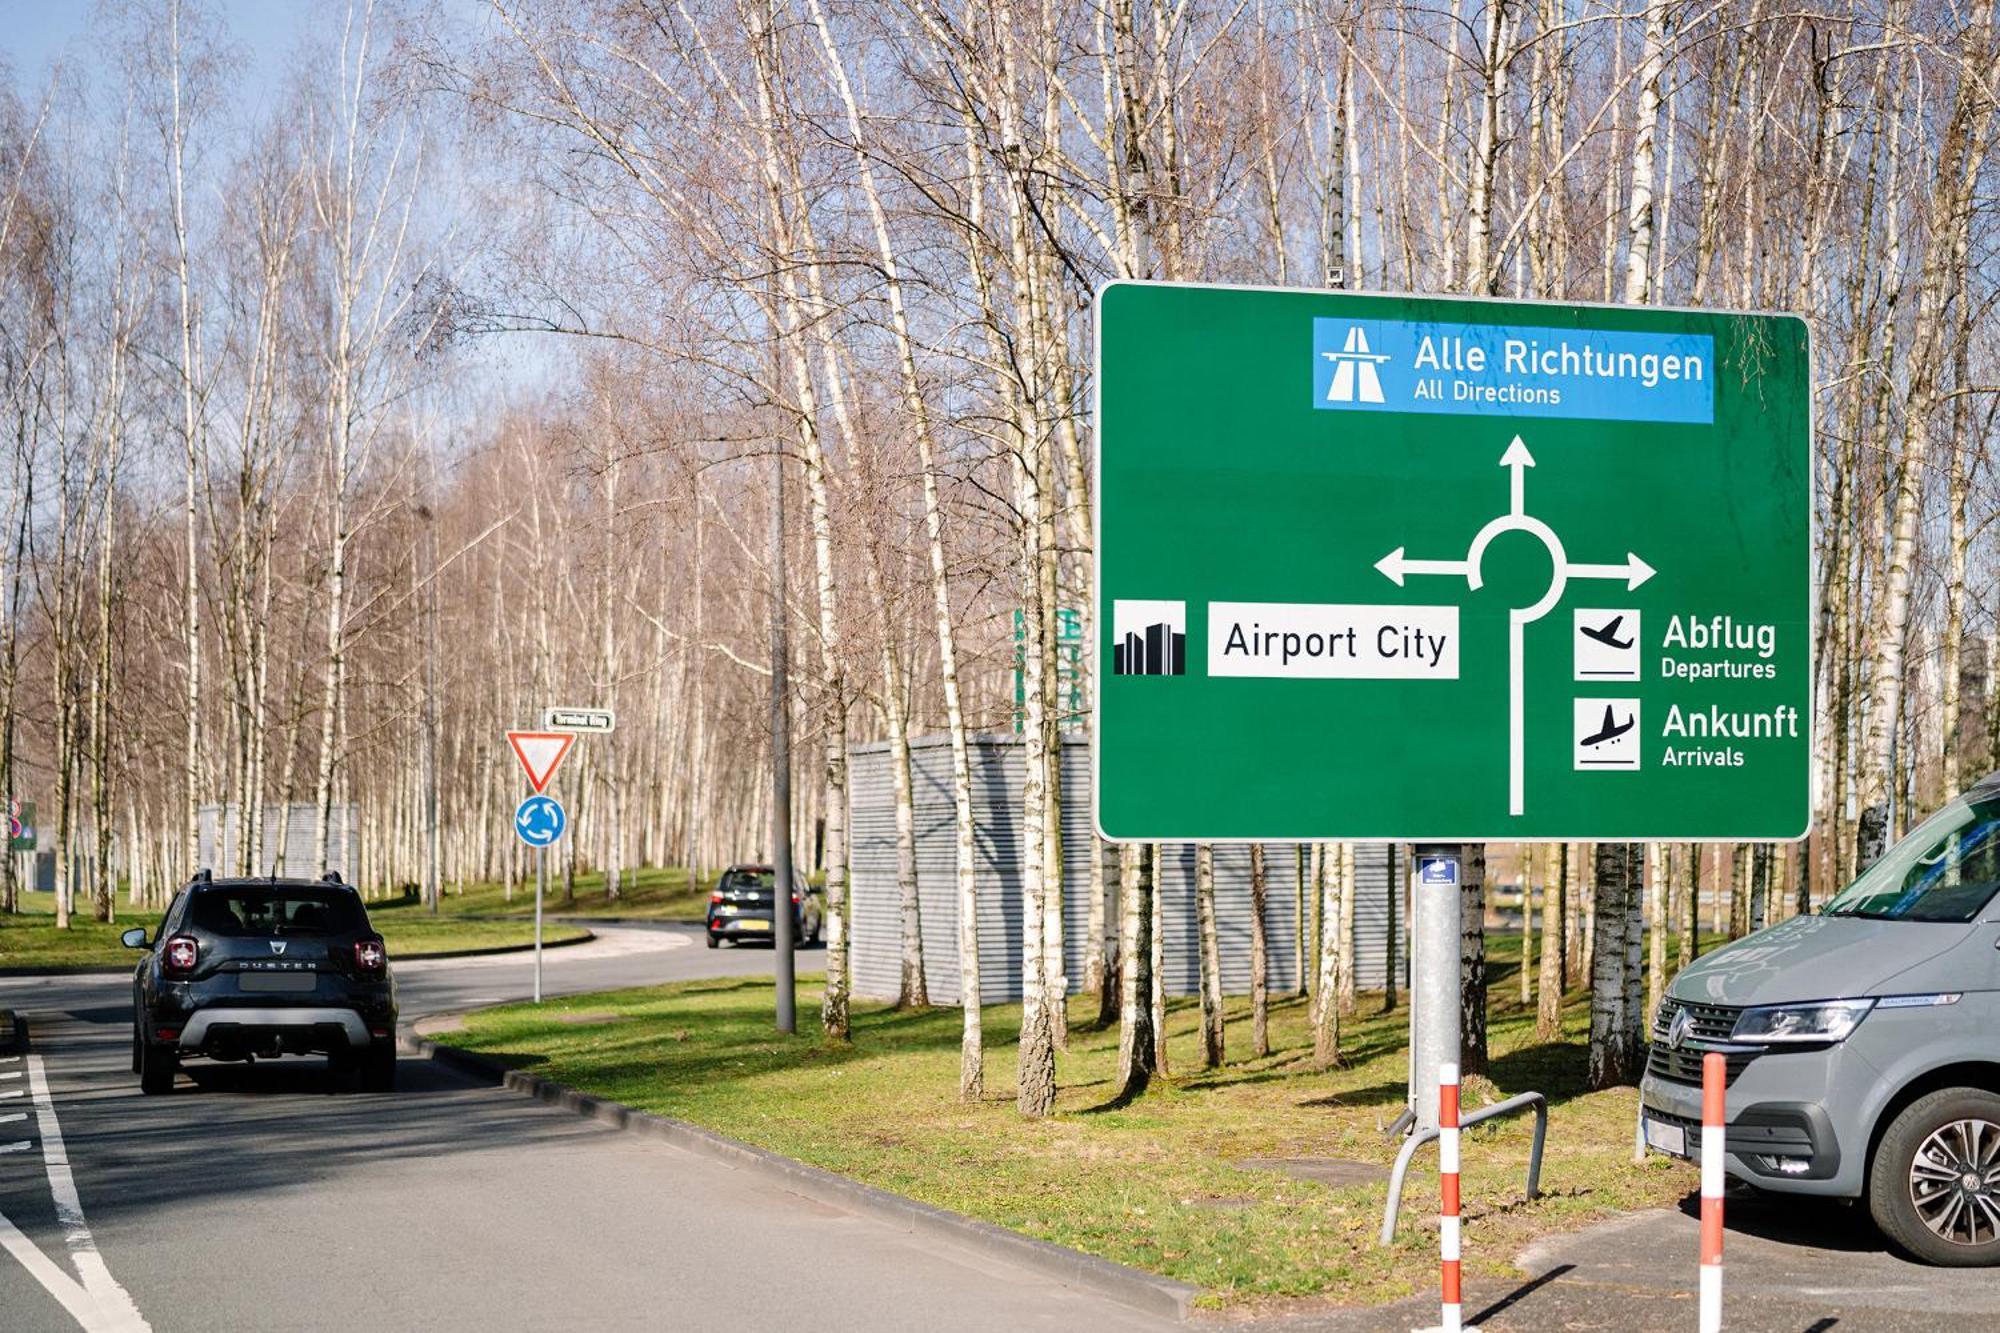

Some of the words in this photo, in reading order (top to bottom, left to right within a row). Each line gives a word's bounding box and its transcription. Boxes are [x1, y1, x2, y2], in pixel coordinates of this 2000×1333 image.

[1414, 336, 1486, 372] Alle
[1504, 339, 1703, 385] Richtungen
[1414, 379, 1444, 400] All
[1453, 380, 1561, 405] Directions
[1223, 622, 1357, 666] Airport
[1377, 625, 1447, 668] City
[1662, 615, 1776, 656] Abflug
[1662, 658, 1776, 683] Departures
[1662, 704, 1798, 738] Ankunft
[1662, 746, 1744, 767] Arrivals
